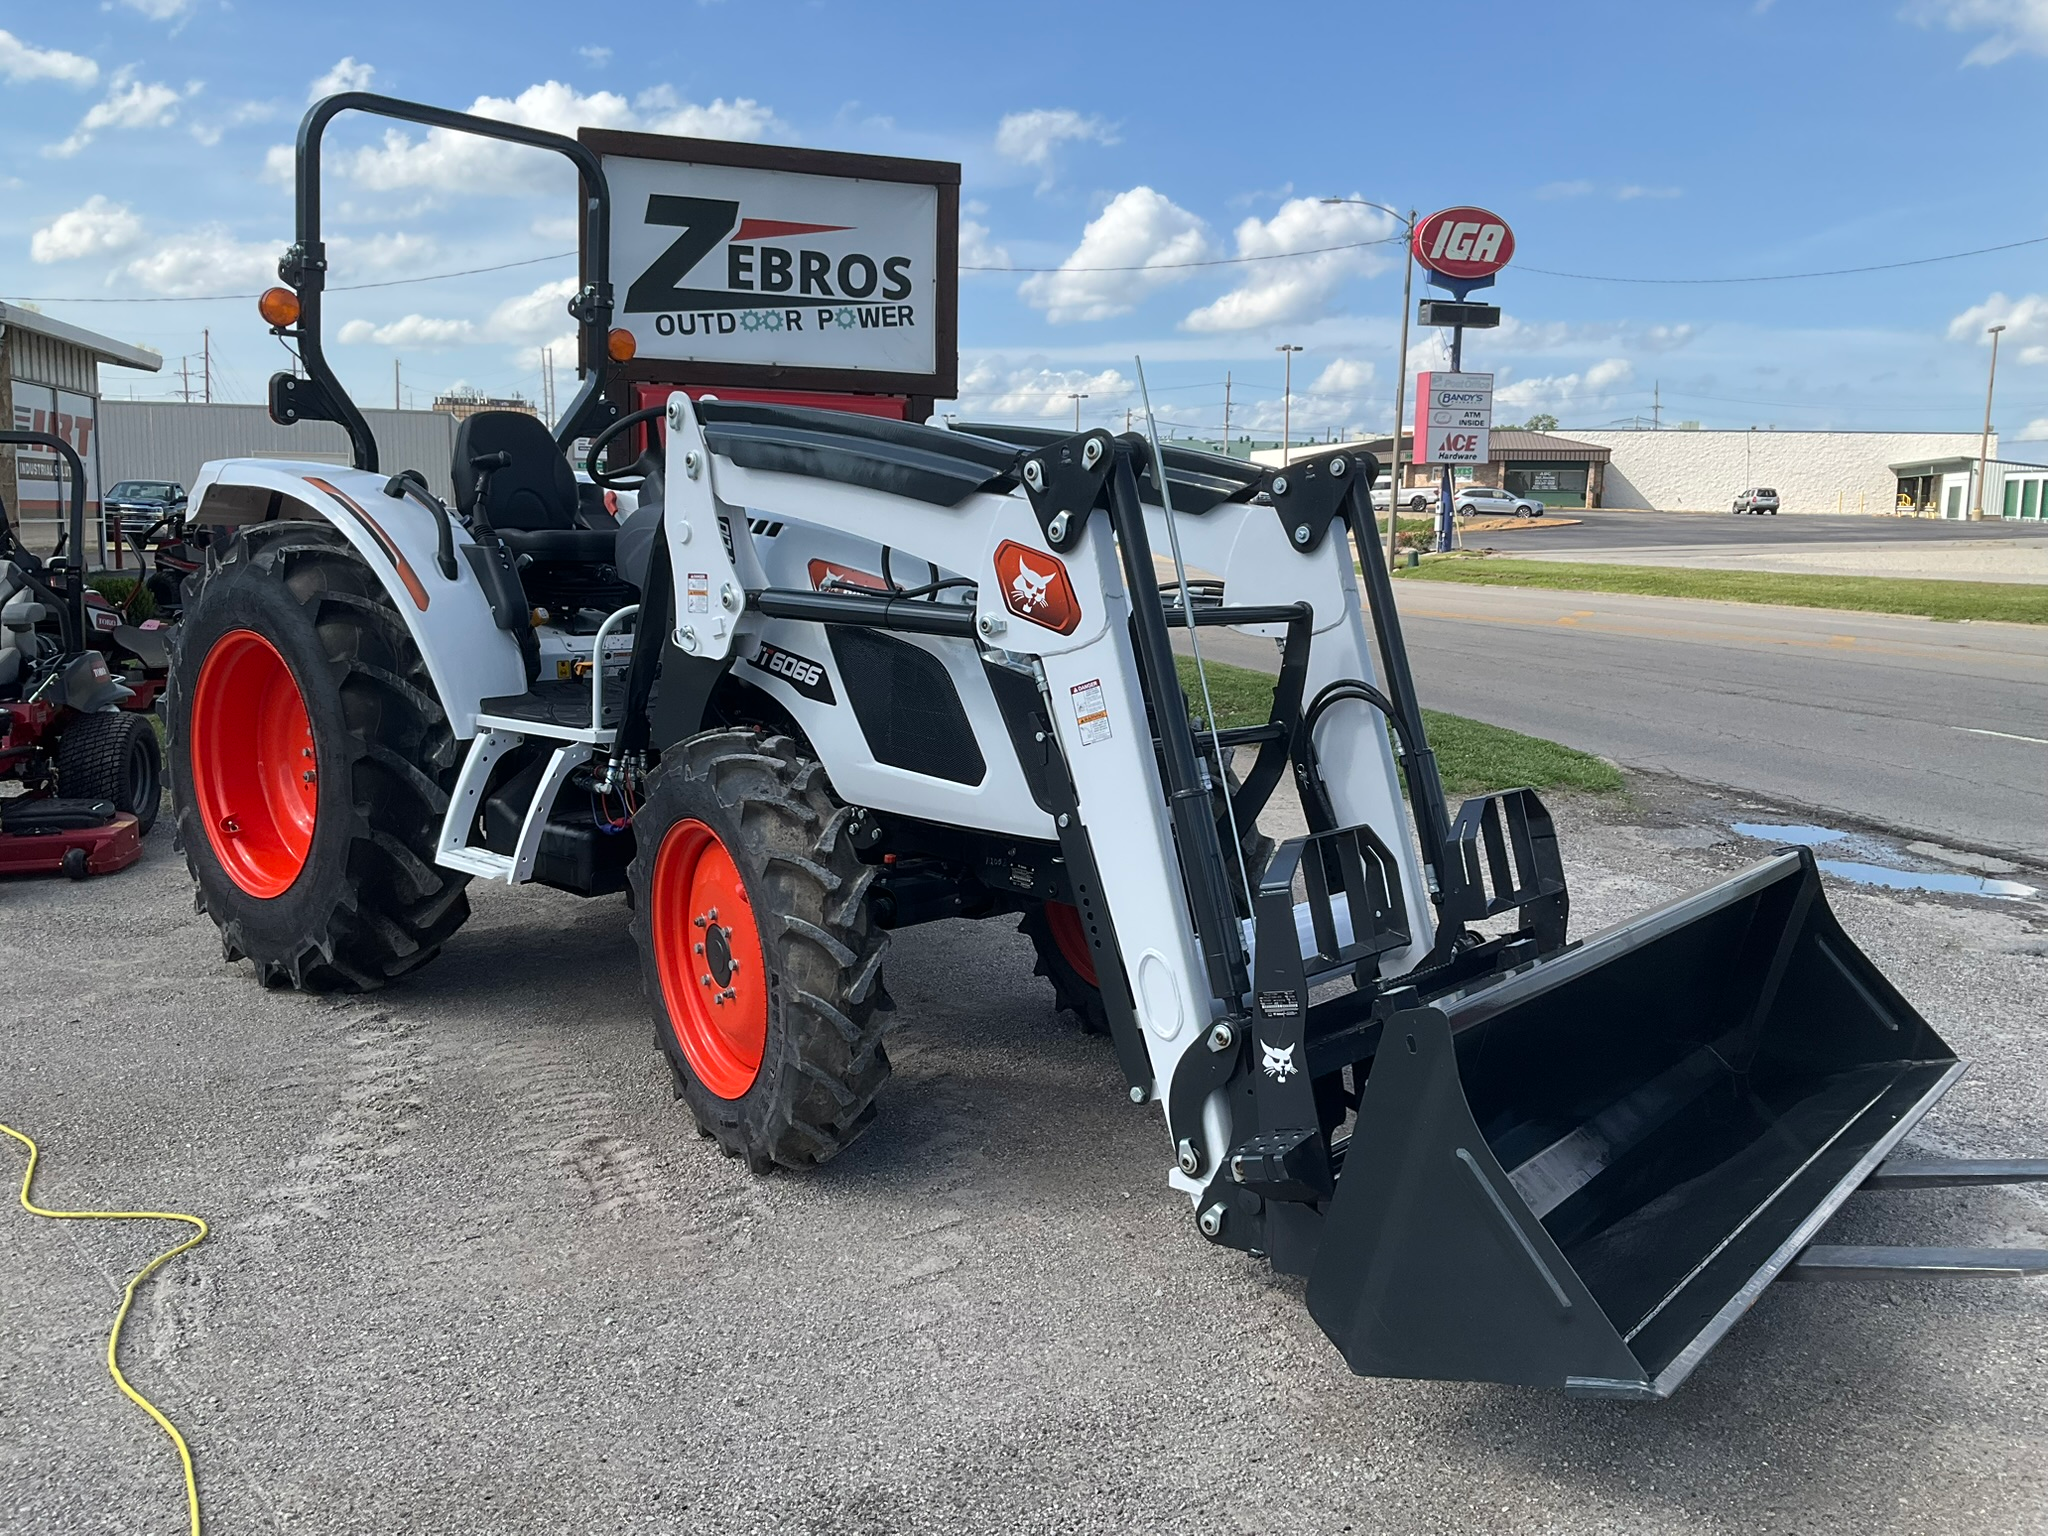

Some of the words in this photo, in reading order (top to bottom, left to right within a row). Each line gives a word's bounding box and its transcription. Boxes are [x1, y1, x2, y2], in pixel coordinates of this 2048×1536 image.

[1429, 220, 1506, 263] IGA
[623, 193, 913, 314] ZEBROS
[1442, 393, 1484, 404] BANDY'S
[1458, 419, 1485, 427] INSIDE
[1438, 432, 1478, 452] ACE
[1438, 452, 1478, 460] Hardware
[97, 617, 117, 626] TORO
